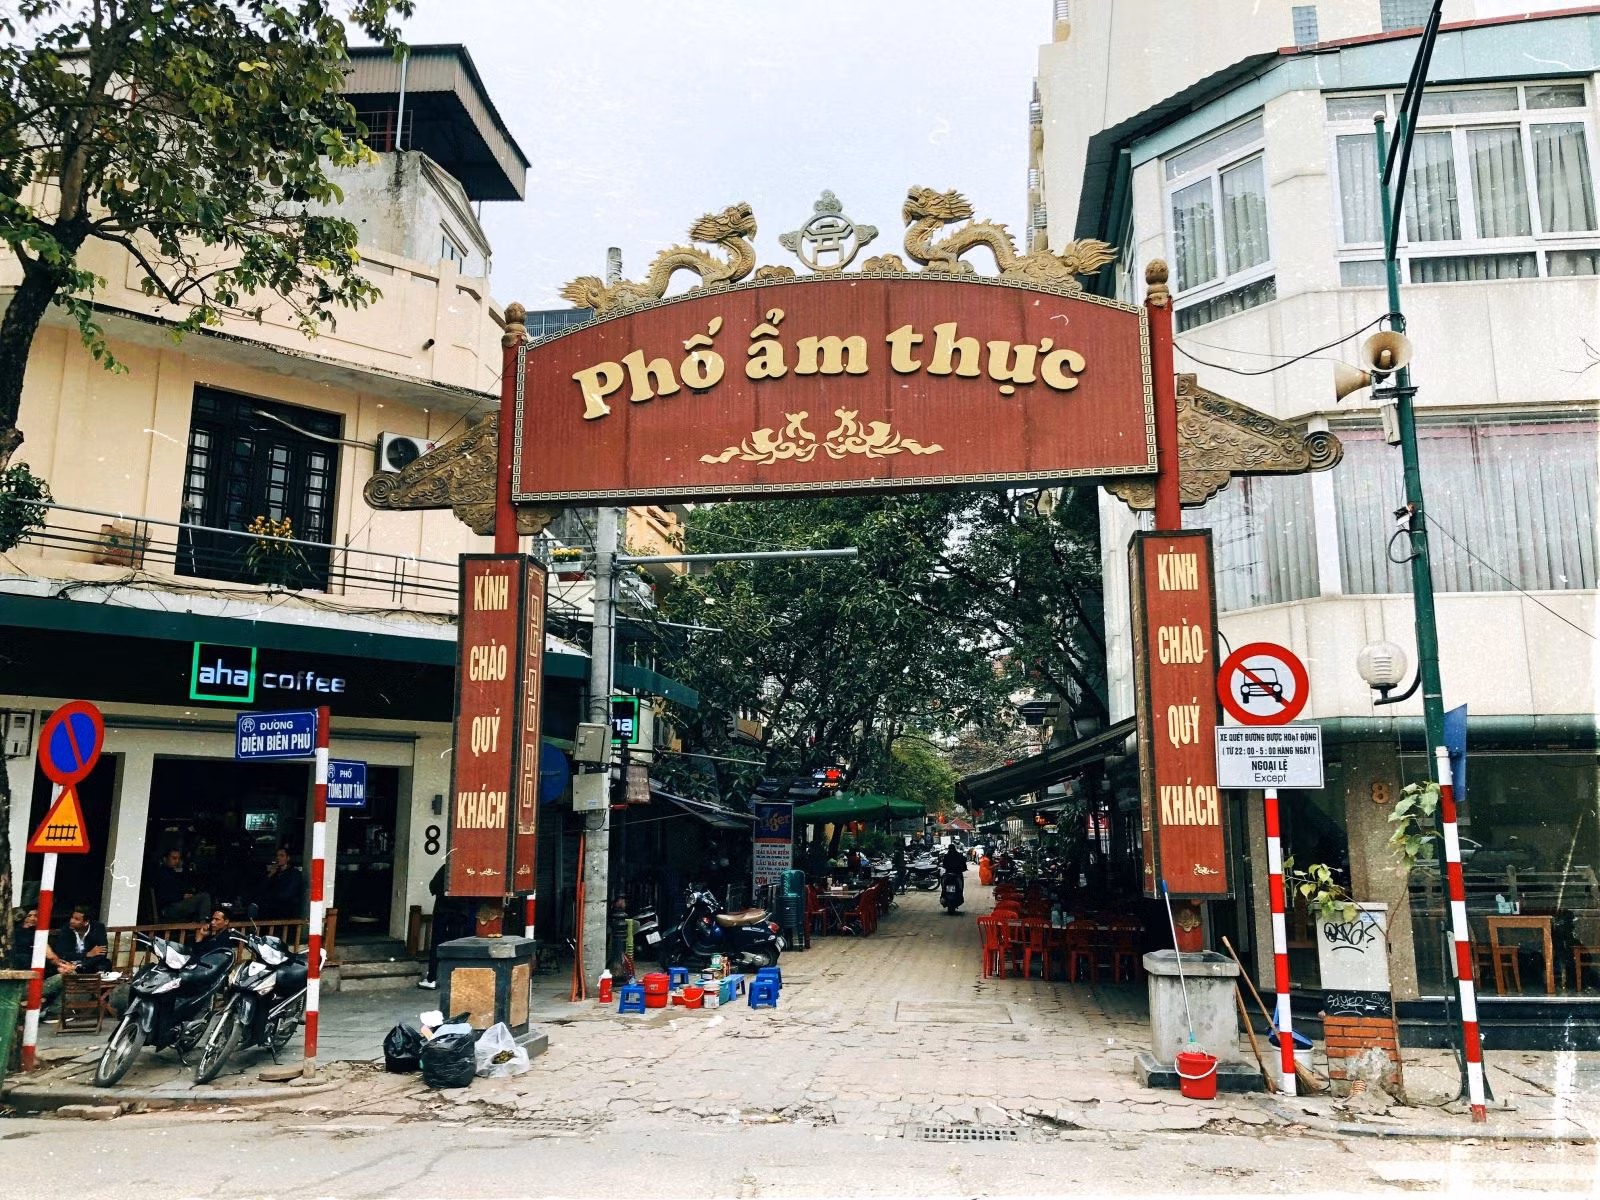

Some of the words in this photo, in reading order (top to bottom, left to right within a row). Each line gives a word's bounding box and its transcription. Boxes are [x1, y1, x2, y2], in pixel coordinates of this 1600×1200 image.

[572, 316, 724, 419] Phố
[745, 308, 868, 380] ẩm
[886, 322, 1086, 394] thực
[1157, 545, 1198, 591] KÍNH
[474, 569, 509, 610] KÍNH
[1157, 617, 1204, 664] CHÀO
[199, 658, 248, 686] aha
[262, 671, 345, 692] coffee
[469, 638, 507, 681] CHÀO
[260, 720, 293, 731] ĐƯỜNG
[471, 708, 500, 757] QUÝ
[1167, 696, 1200, 749] QUÝ
[1219, 733, 1228, 741] XE
[1229, 732, 1243, 741] QUÉT
[1266, 732, 1282, 743] ĐƯỢC
[1300, 731, 1317, 743] ĐỘNG
[241, 733, 264, 755] ĐIỆN
[267, 732, 289, 751] BIÊN
[291, 728, 310, 750] PHỦ
[340, 768, 352, 779] PHỐ
[1251, 760, 1276, 772] NGOẠI
[1279, 759, 1288, 772] LỆ
[1254, 773, 1287, 784] Except
[342, 784, 352, 799] DUY
[456, 784, 507, 829] KHÁCH
[1160, 777, 1219, 826] KHÁCH
[1371, 782, 1388, 804] 8
[424, 825, 440, 855] 8
